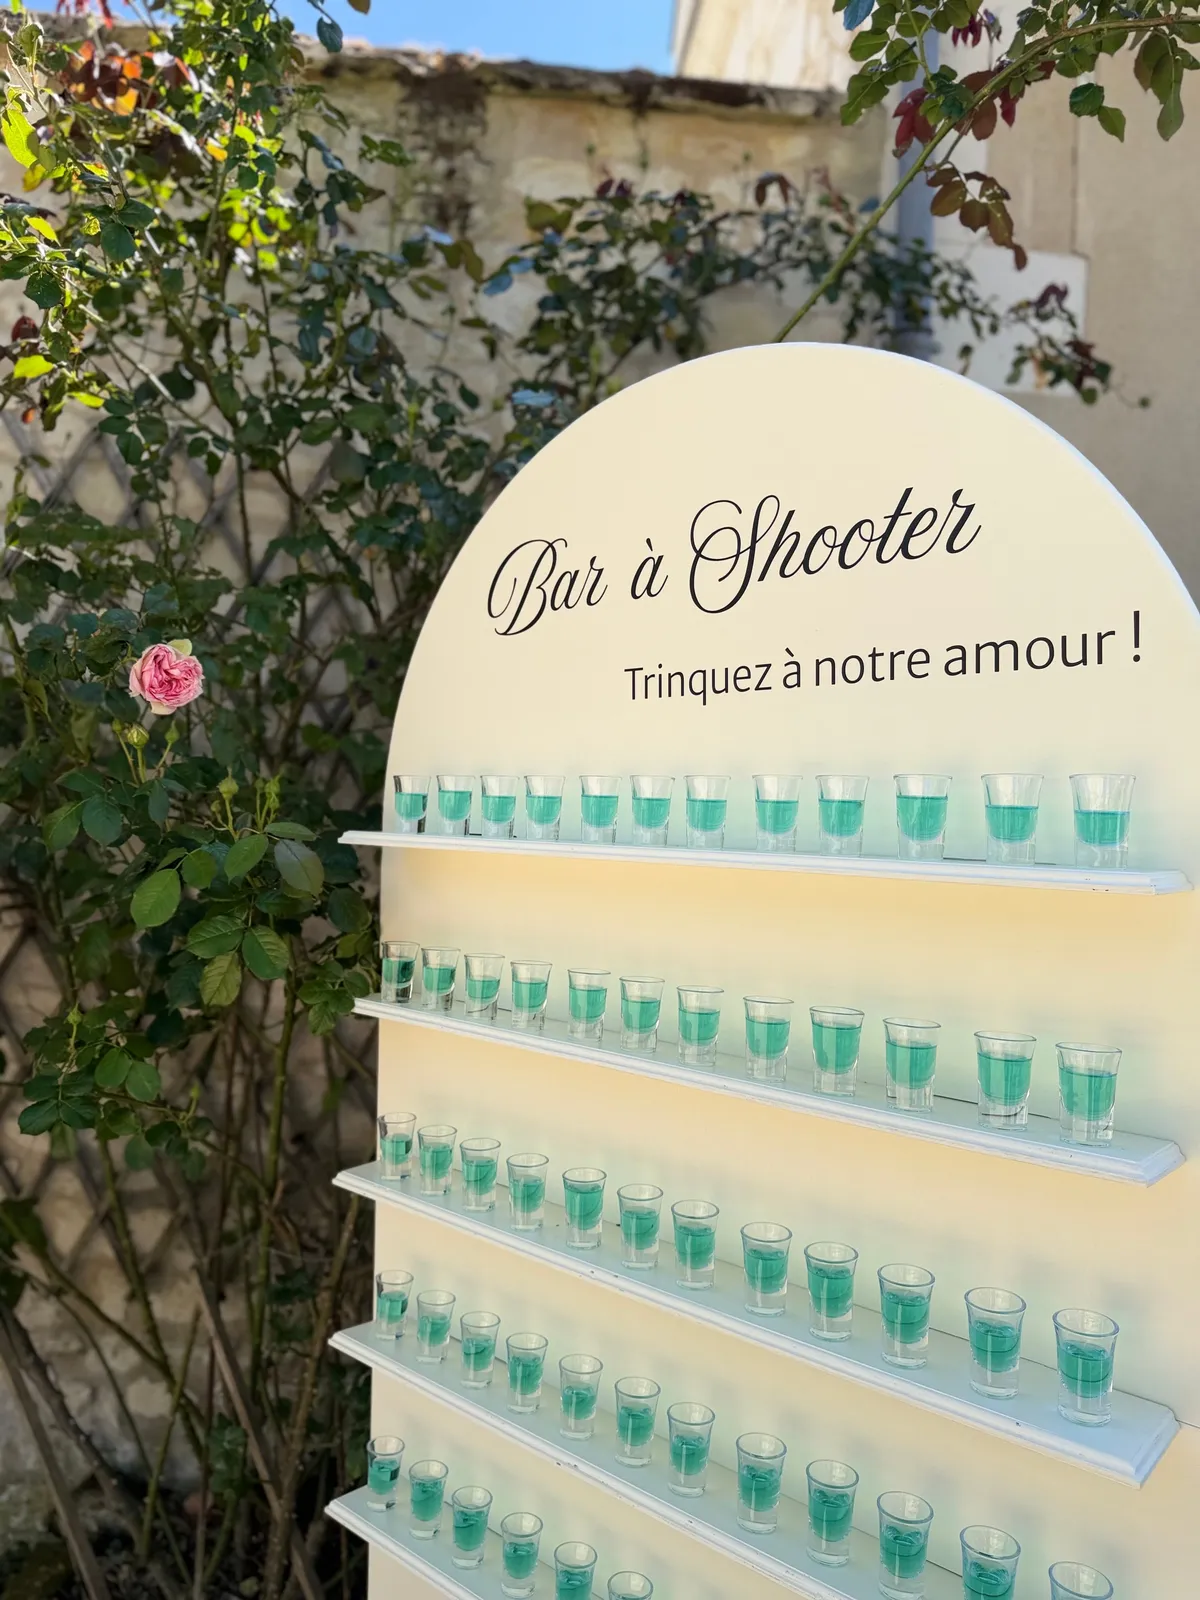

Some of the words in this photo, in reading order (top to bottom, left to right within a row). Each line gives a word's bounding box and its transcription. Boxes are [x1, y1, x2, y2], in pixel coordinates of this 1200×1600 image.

[487, 537, 608, 636] Bar
[630, 537, 669, 600] à
[689, 486, 982, 614] Shooter
[623, 662, 772, 706] Trinquez
[782, 647, 801, 692] à
[815, 645, 931, 687] notre
[944, 630, 1116, 677] amour
